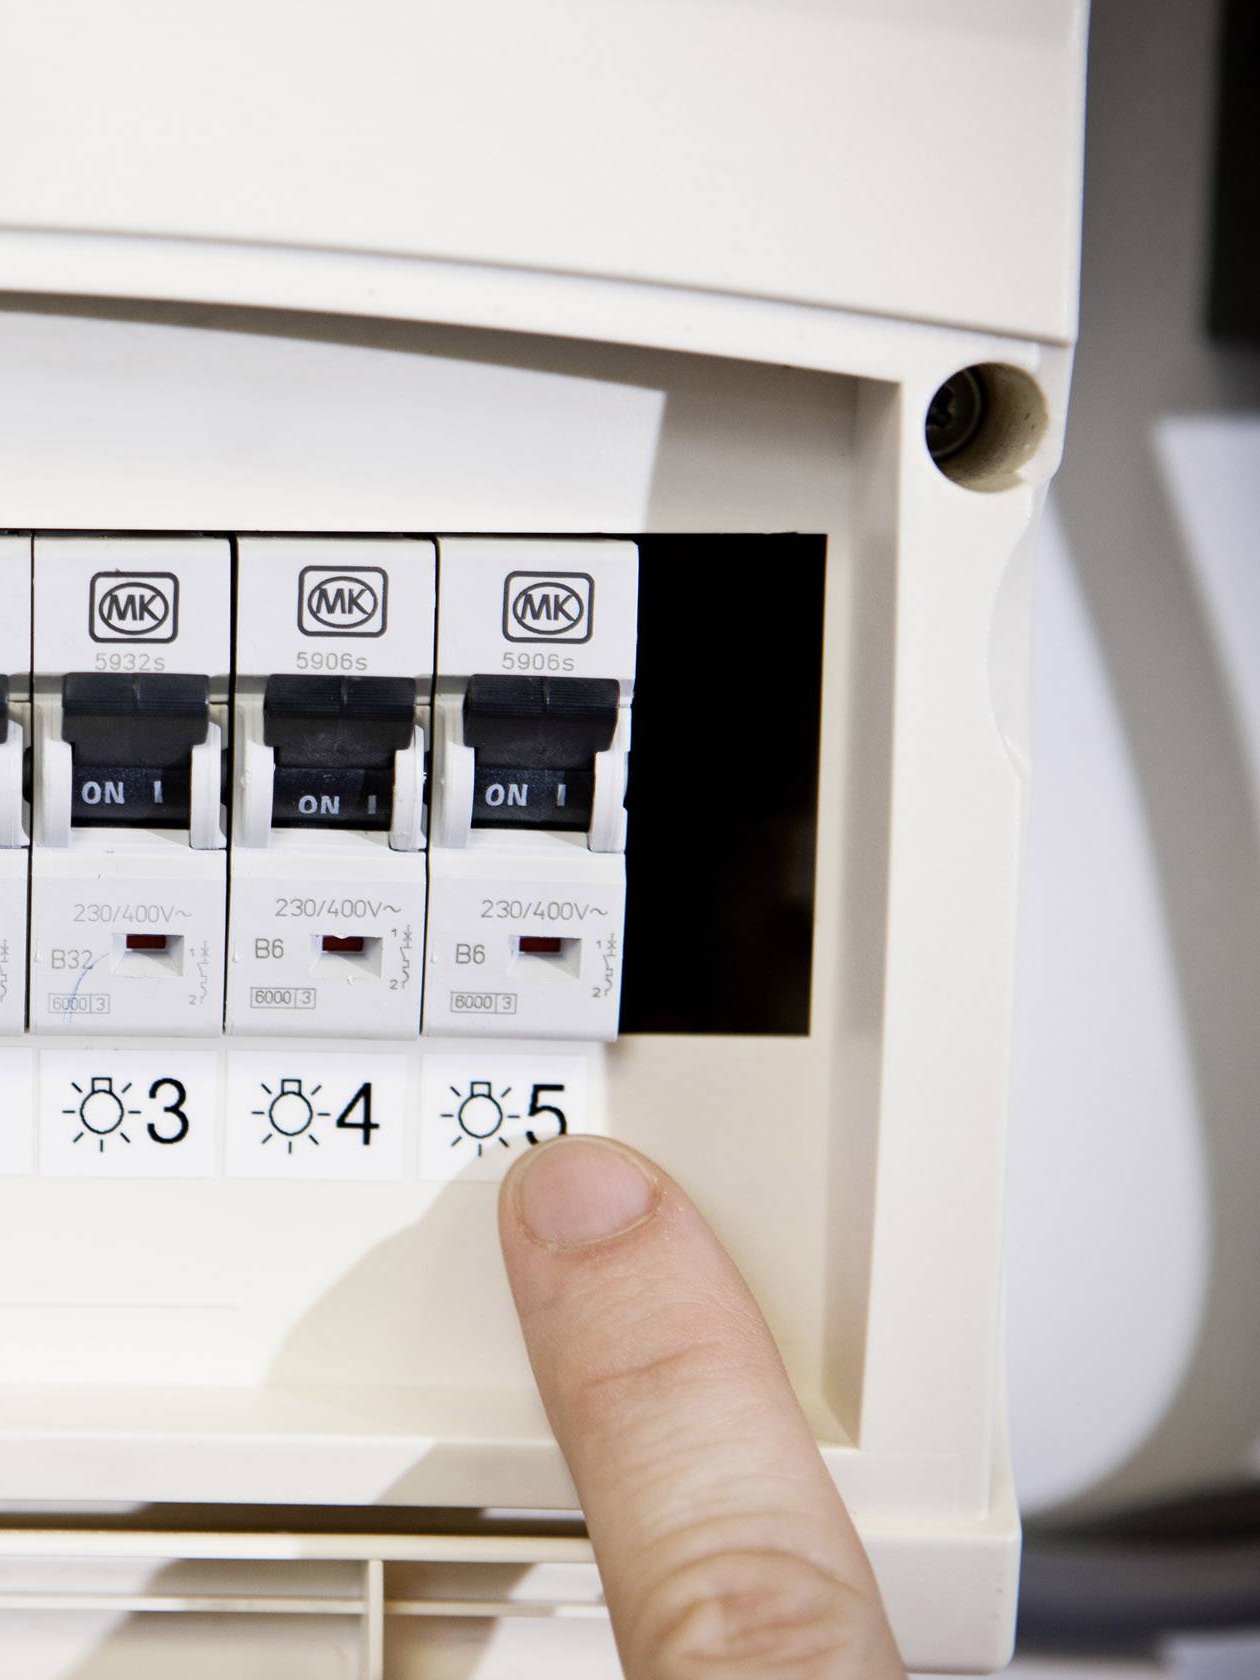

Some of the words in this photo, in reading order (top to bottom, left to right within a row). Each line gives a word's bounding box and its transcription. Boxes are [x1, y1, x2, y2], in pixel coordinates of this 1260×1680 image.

[106, 593, 162, 622] MK
[315, 587, 370, 616] MK
[519, 592, 577, 623] MK
[94, 652, 166, 673] 5932s
[295, 650, 368, 672] 5906s
[501, 651, 575, 673] 5906s
[80, 780, 126, 805] ON
[297, 794, 341, 815] ON
[484, 782, 529, 808] ON
[51, 948, 94, 971] B32
[254, 937, 285, 960] B6
[454, 942, 487, 966] B6
[146, 1076, 190, 1145] 3
[335, 1081, 380, 1147] 4
[525, 1083, 569, 1146] 5
